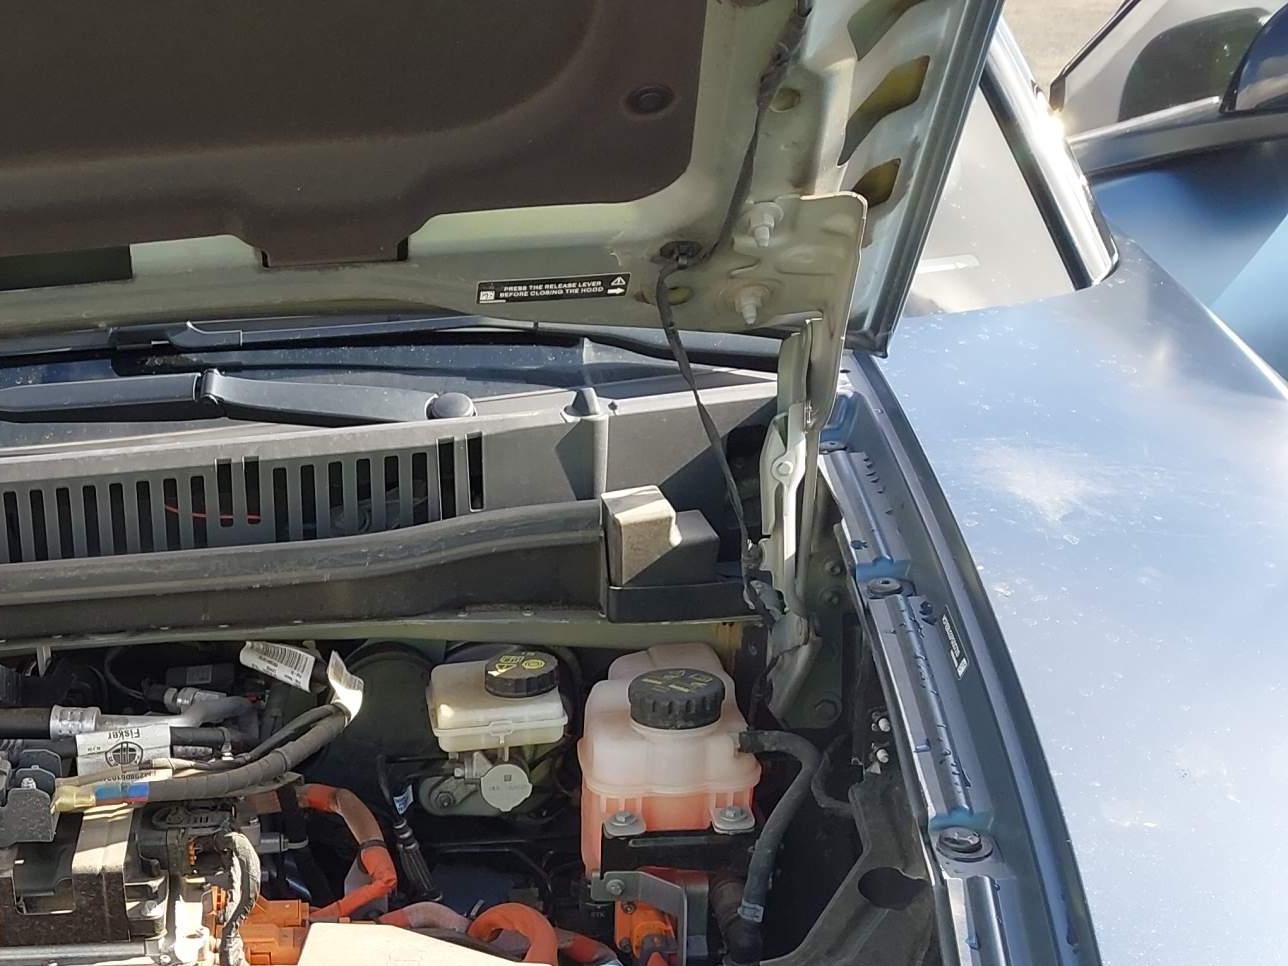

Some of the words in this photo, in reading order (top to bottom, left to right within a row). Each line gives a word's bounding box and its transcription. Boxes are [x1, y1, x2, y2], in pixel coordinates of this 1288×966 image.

[544, 282, 577, 290] RELEASE
[577, 280, 602, 288] LEVER
[529, 289, 564, 297] CLOSING
[580, 286, 604, 294] HOOD
[107, 728, 141, 740] Fisker
